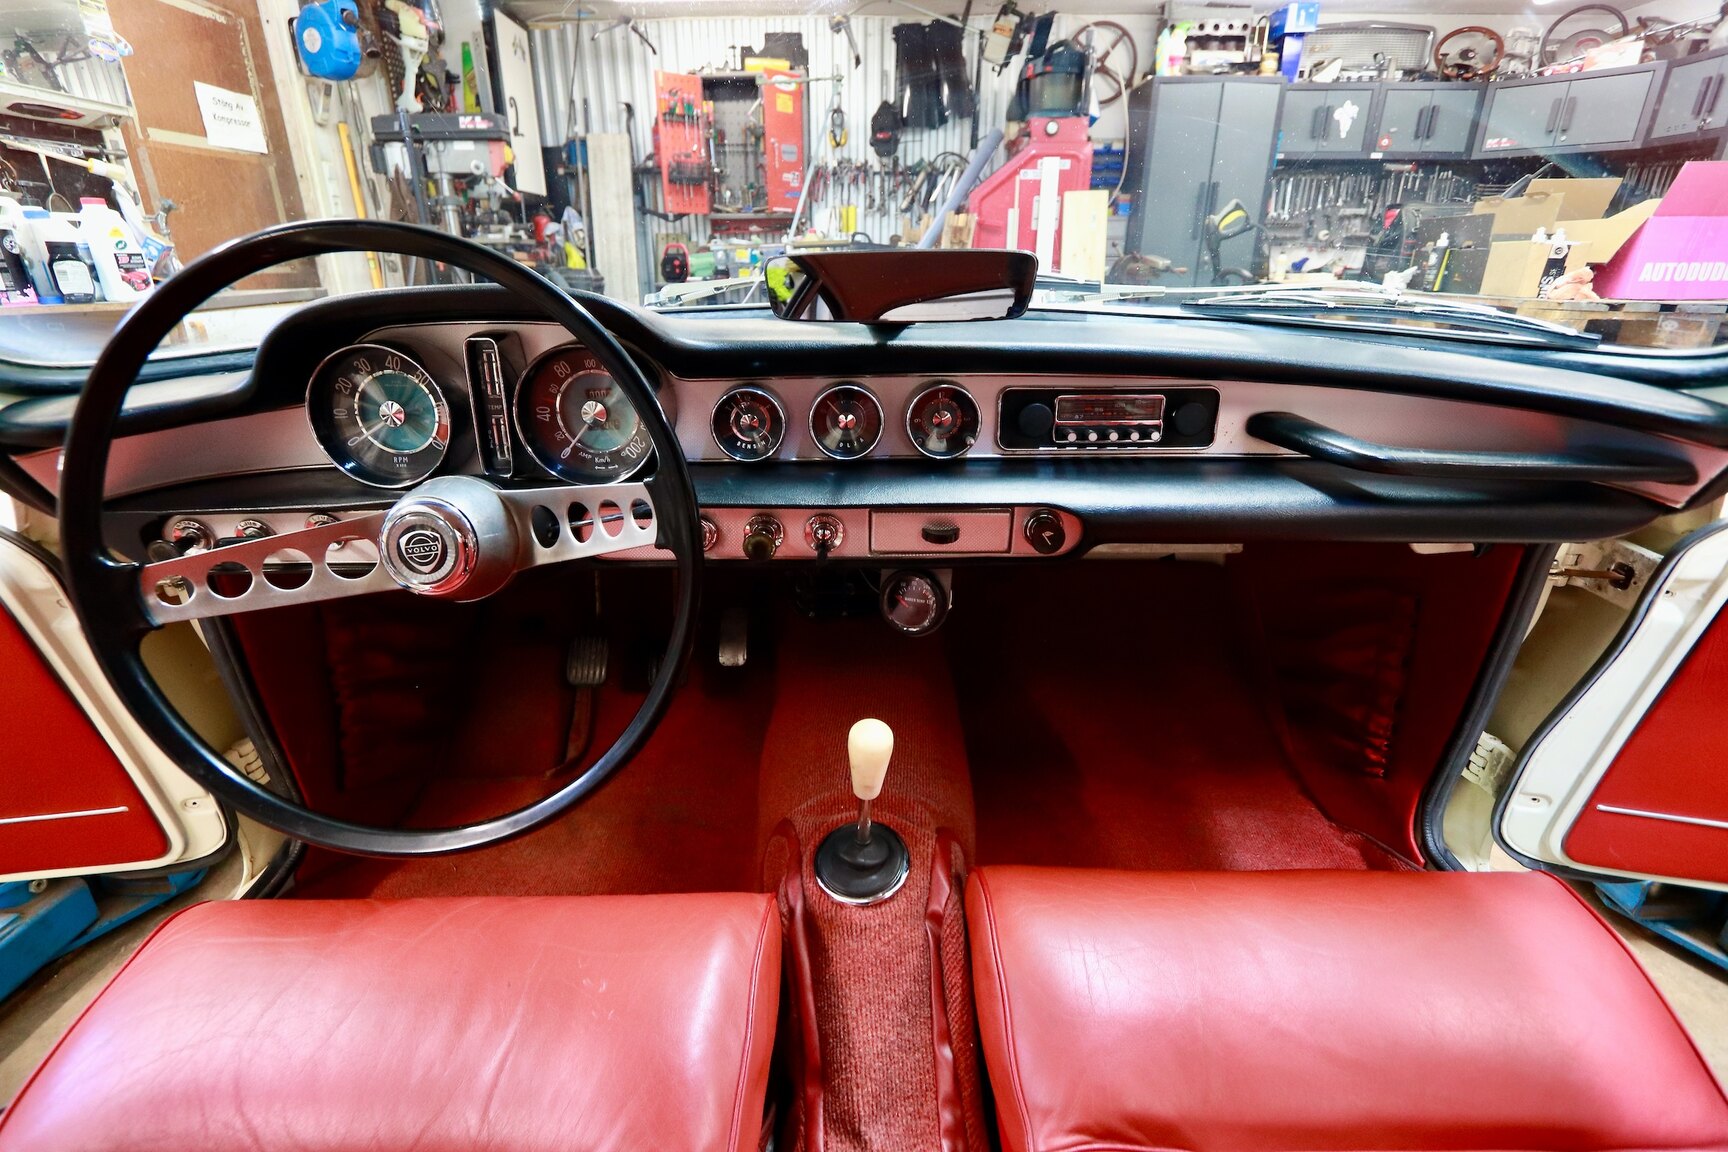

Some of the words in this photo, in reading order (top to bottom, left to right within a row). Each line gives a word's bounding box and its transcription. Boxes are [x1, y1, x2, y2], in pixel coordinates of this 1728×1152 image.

[353, 358, 371, 375] 30
[385, 355, 401, 371] 40
[584, 359, 596, 368] 100
[553, 360, 571, 378] 80
[414, 370, 429, 386] 50
[335, 377, 353, 395] 20
[548, 383, 560, 394] 60
[333, 408, 349, 419] 10
[535, 406, 552, 422] 40
[555, 431, 566, 441] 20
[625, 435, 646, 459] 200
[736, 441, 766, 450] BENSIN
[839, 437, 864, 448] OLJA
[393, 456, 409, 464] RPM
[407, 545, 438, 554] VOLVO
